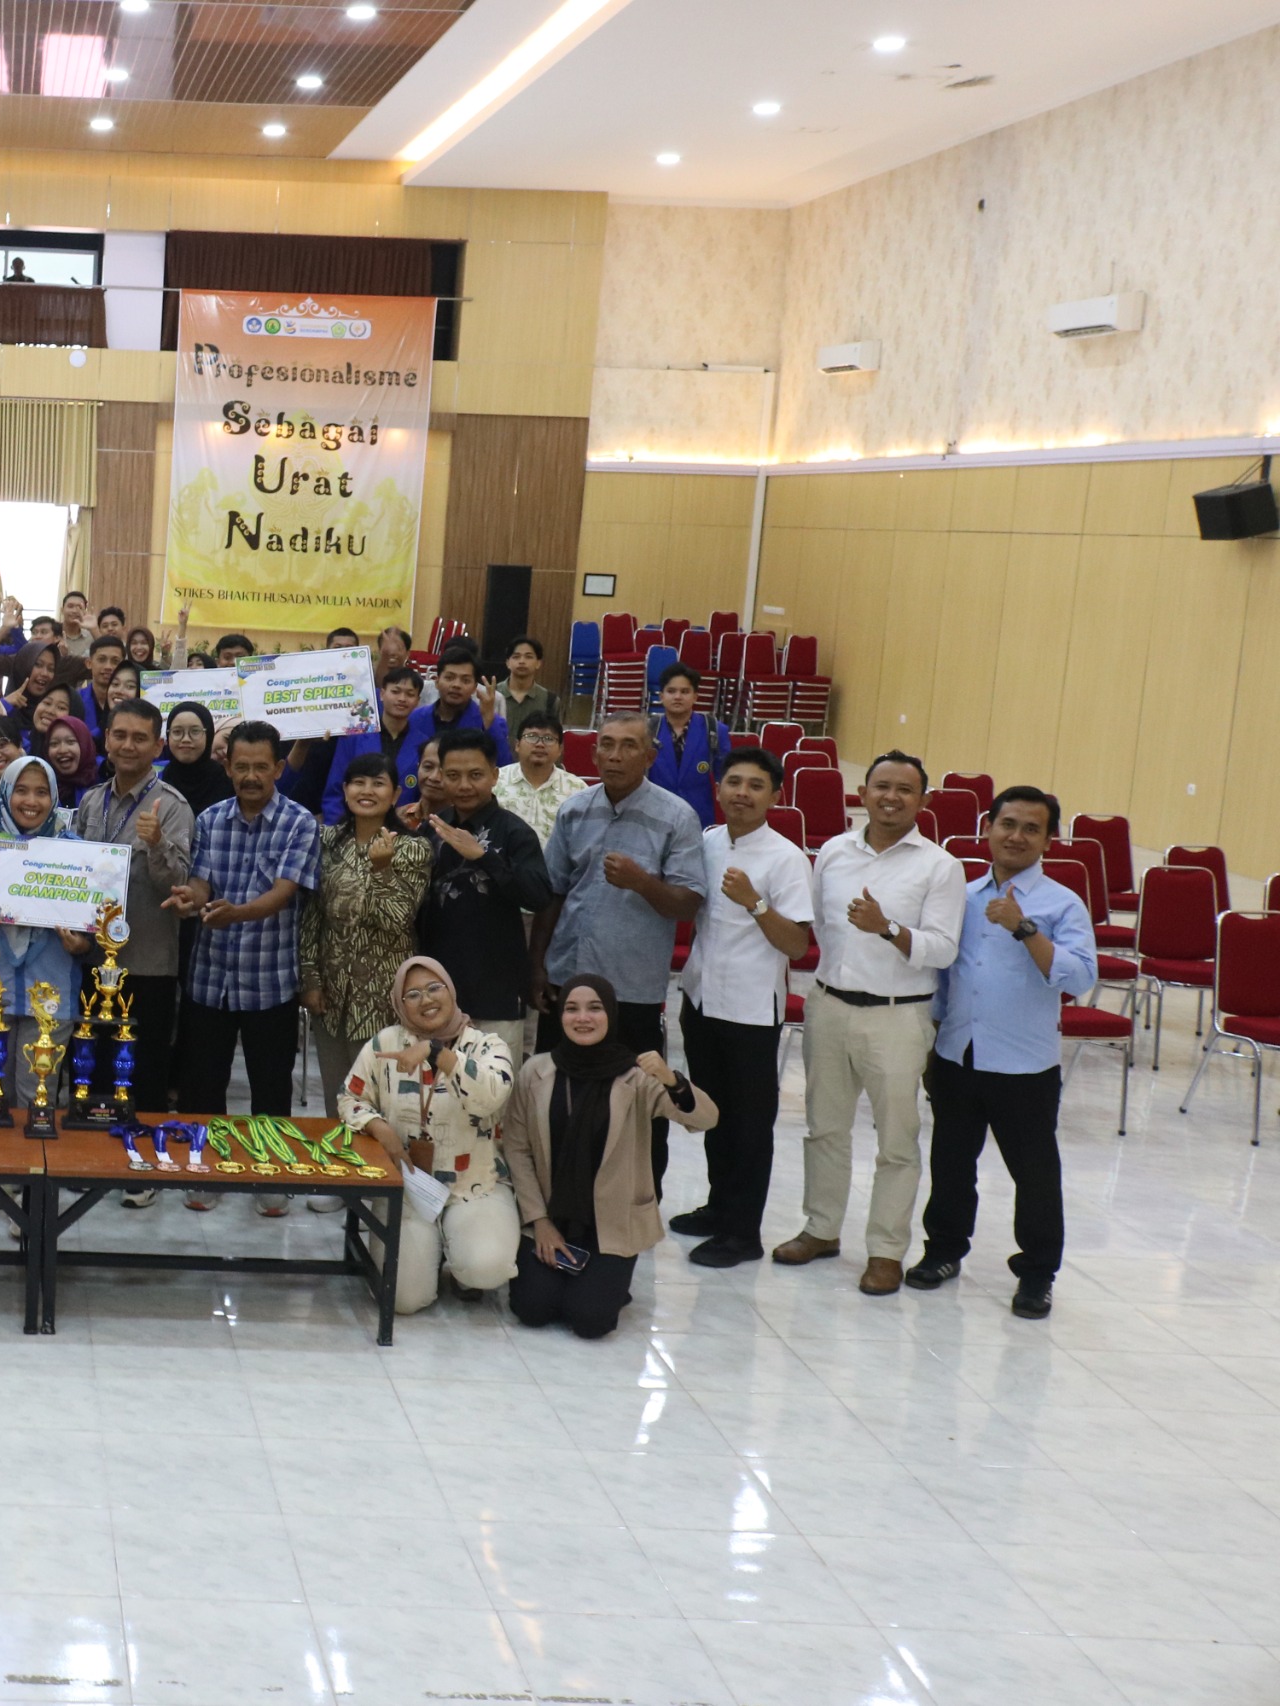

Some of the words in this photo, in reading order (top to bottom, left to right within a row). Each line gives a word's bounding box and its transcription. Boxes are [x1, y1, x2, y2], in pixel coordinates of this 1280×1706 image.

[193, 343, 418, 388] Profesionalisme
[222, 400, 380, 451] Sebagai
[253, 454, 354, 498] Urat
[224, 510, 367, 556] Nadiku
[174, 586, 215, 600] STIKES
[218, 588, 260, 602] BHAKTI
[263, 591, 312, 605] HUSADA
[315, 594, 352, 607] MULIA
[355, 596, 403, 609] MADIUN
[266, 674, 334, 687] Congratulation
[337, 673, 347, 681] To
[164, 689, 222, 699] Congratulation
[223, 688, 232, 696] To
[263, 689, 301, 704] BEST
[303, 684, 354, 701] SPIKER
[266, 706, 303, 716] WOMEN'S
[304, 703, 352, 713] VOLLEYBALL
[22, 859, 82, 872] Congratulation
[85, 865, 94, 873] To
[24, 871, 89, 889] OVERALL
[8, 883, 91, 903] CHAMPION
[91, 892, 104, 904] II
